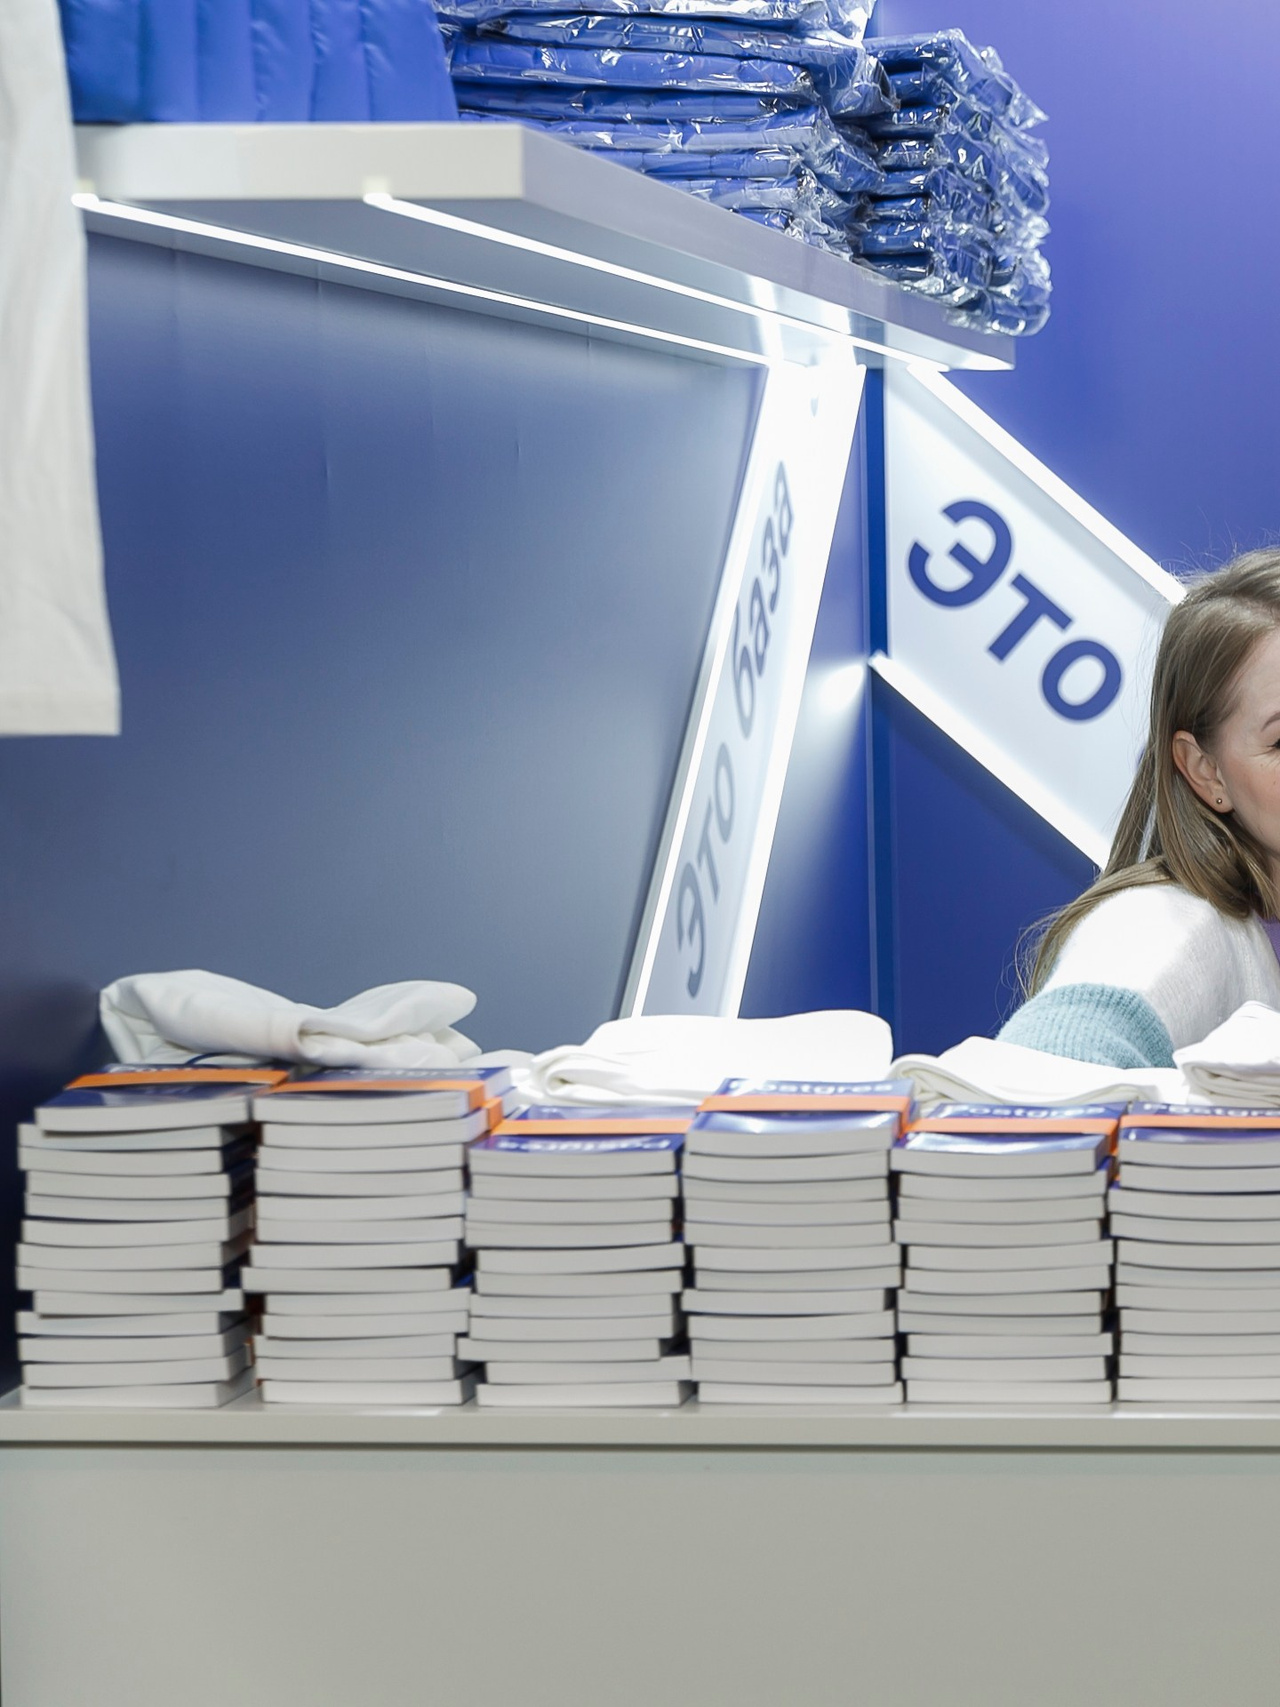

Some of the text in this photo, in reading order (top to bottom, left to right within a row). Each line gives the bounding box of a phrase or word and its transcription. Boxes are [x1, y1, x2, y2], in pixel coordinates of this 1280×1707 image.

[677, 460, 794, 999] Это база
[908, 499, 1123, 722] Это
